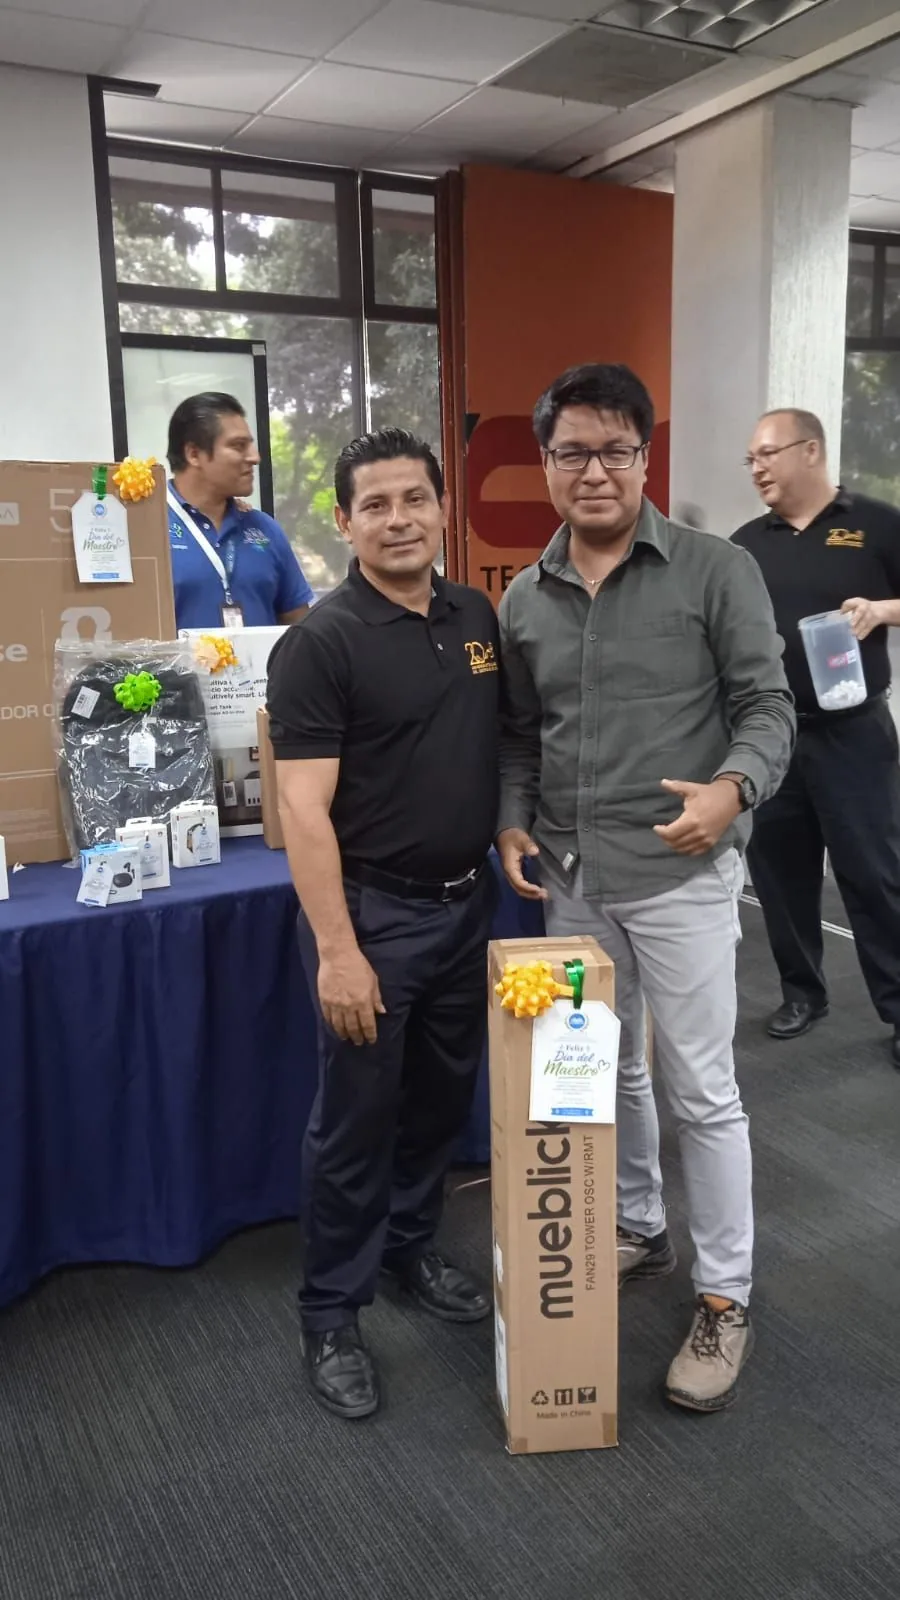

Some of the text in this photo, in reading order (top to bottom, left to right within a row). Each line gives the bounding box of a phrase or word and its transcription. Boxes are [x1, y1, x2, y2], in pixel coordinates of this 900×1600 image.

[480, 565, 531, 592] TE
[543, 1059, 599, 1077] Maestro
[582, 1134, 597, 1291] FAN29 TOWER OSC W/RMT
[536, 1411, 559, 1419] Made
[569, 1409, 592, 1417] China
